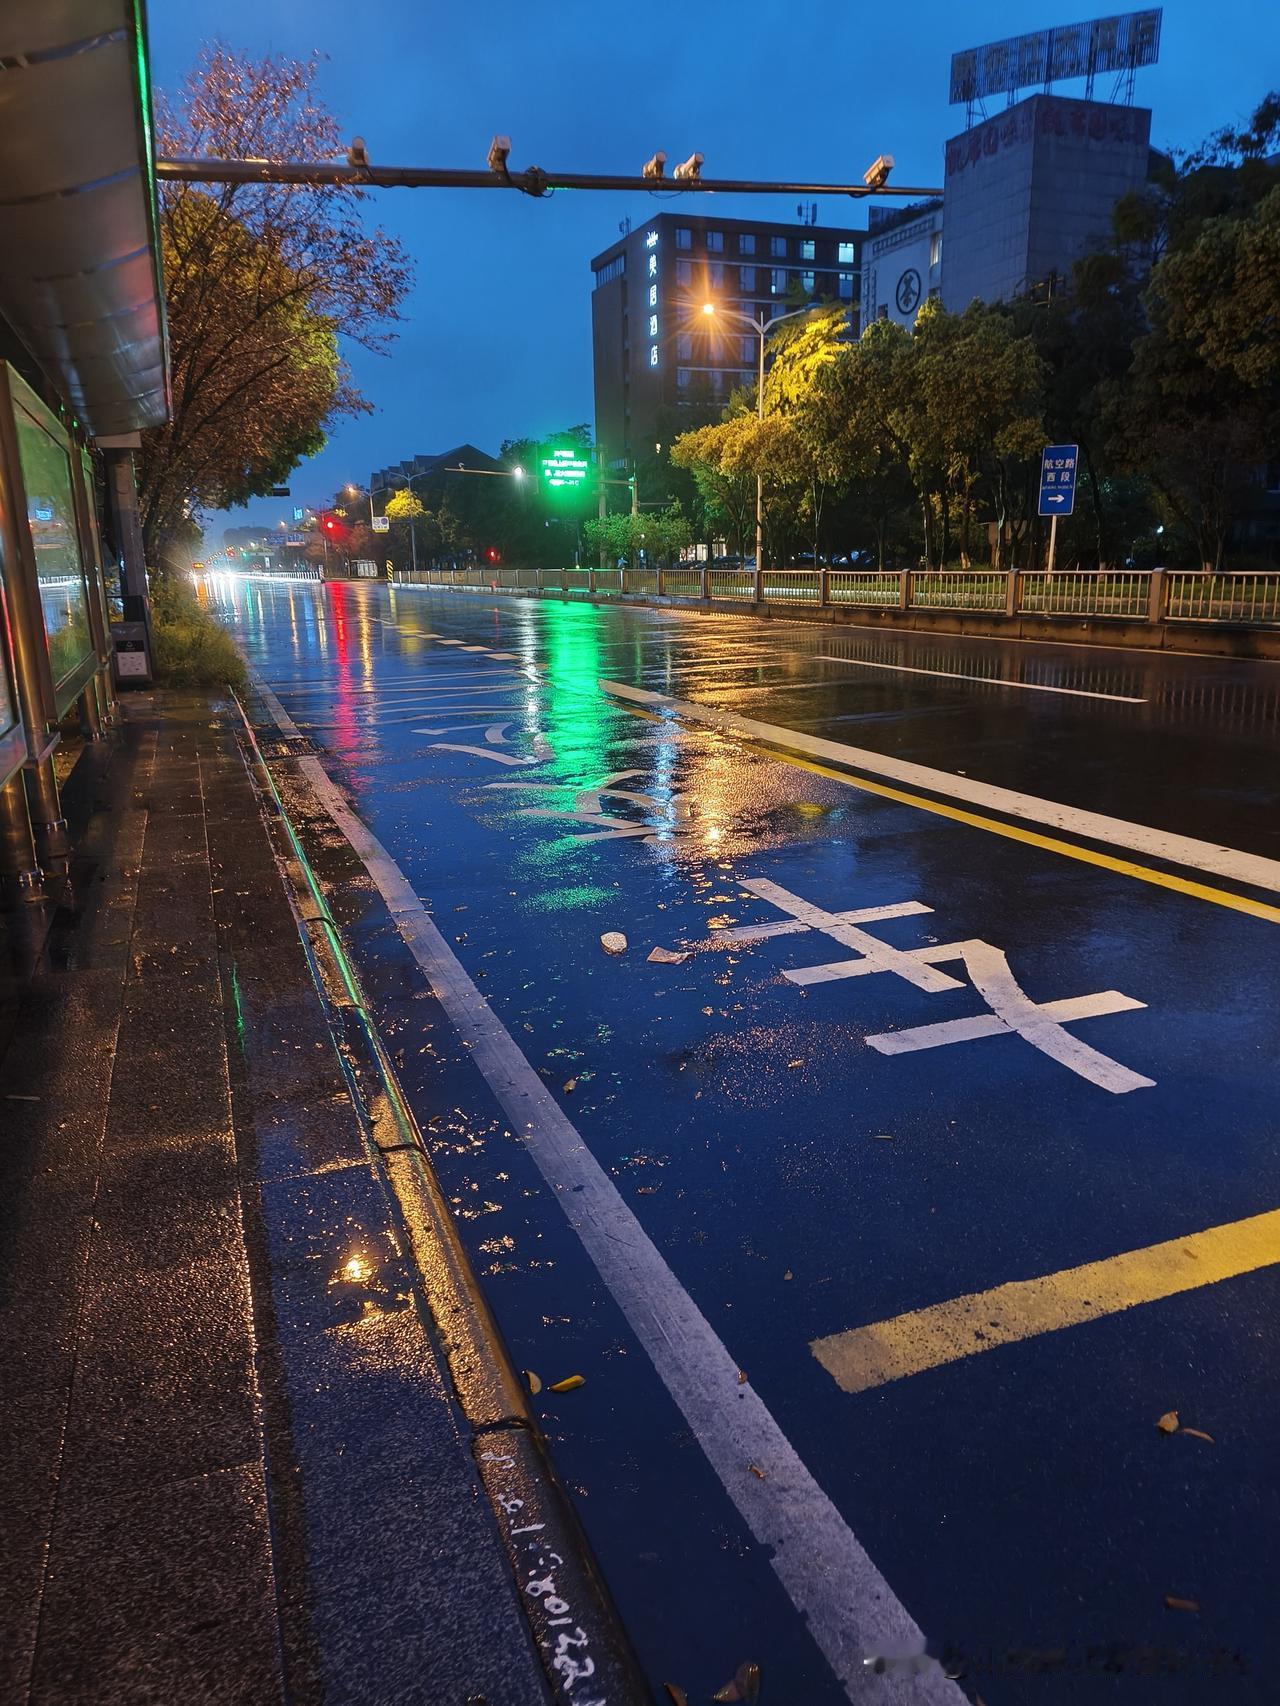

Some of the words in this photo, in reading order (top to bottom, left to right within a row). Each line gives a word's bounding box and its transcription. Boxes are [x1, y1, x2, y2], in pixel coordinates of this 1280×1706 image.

[1044, 458, 1075, 470] 航空路
[1046, 471, 1071, 482] 西段
